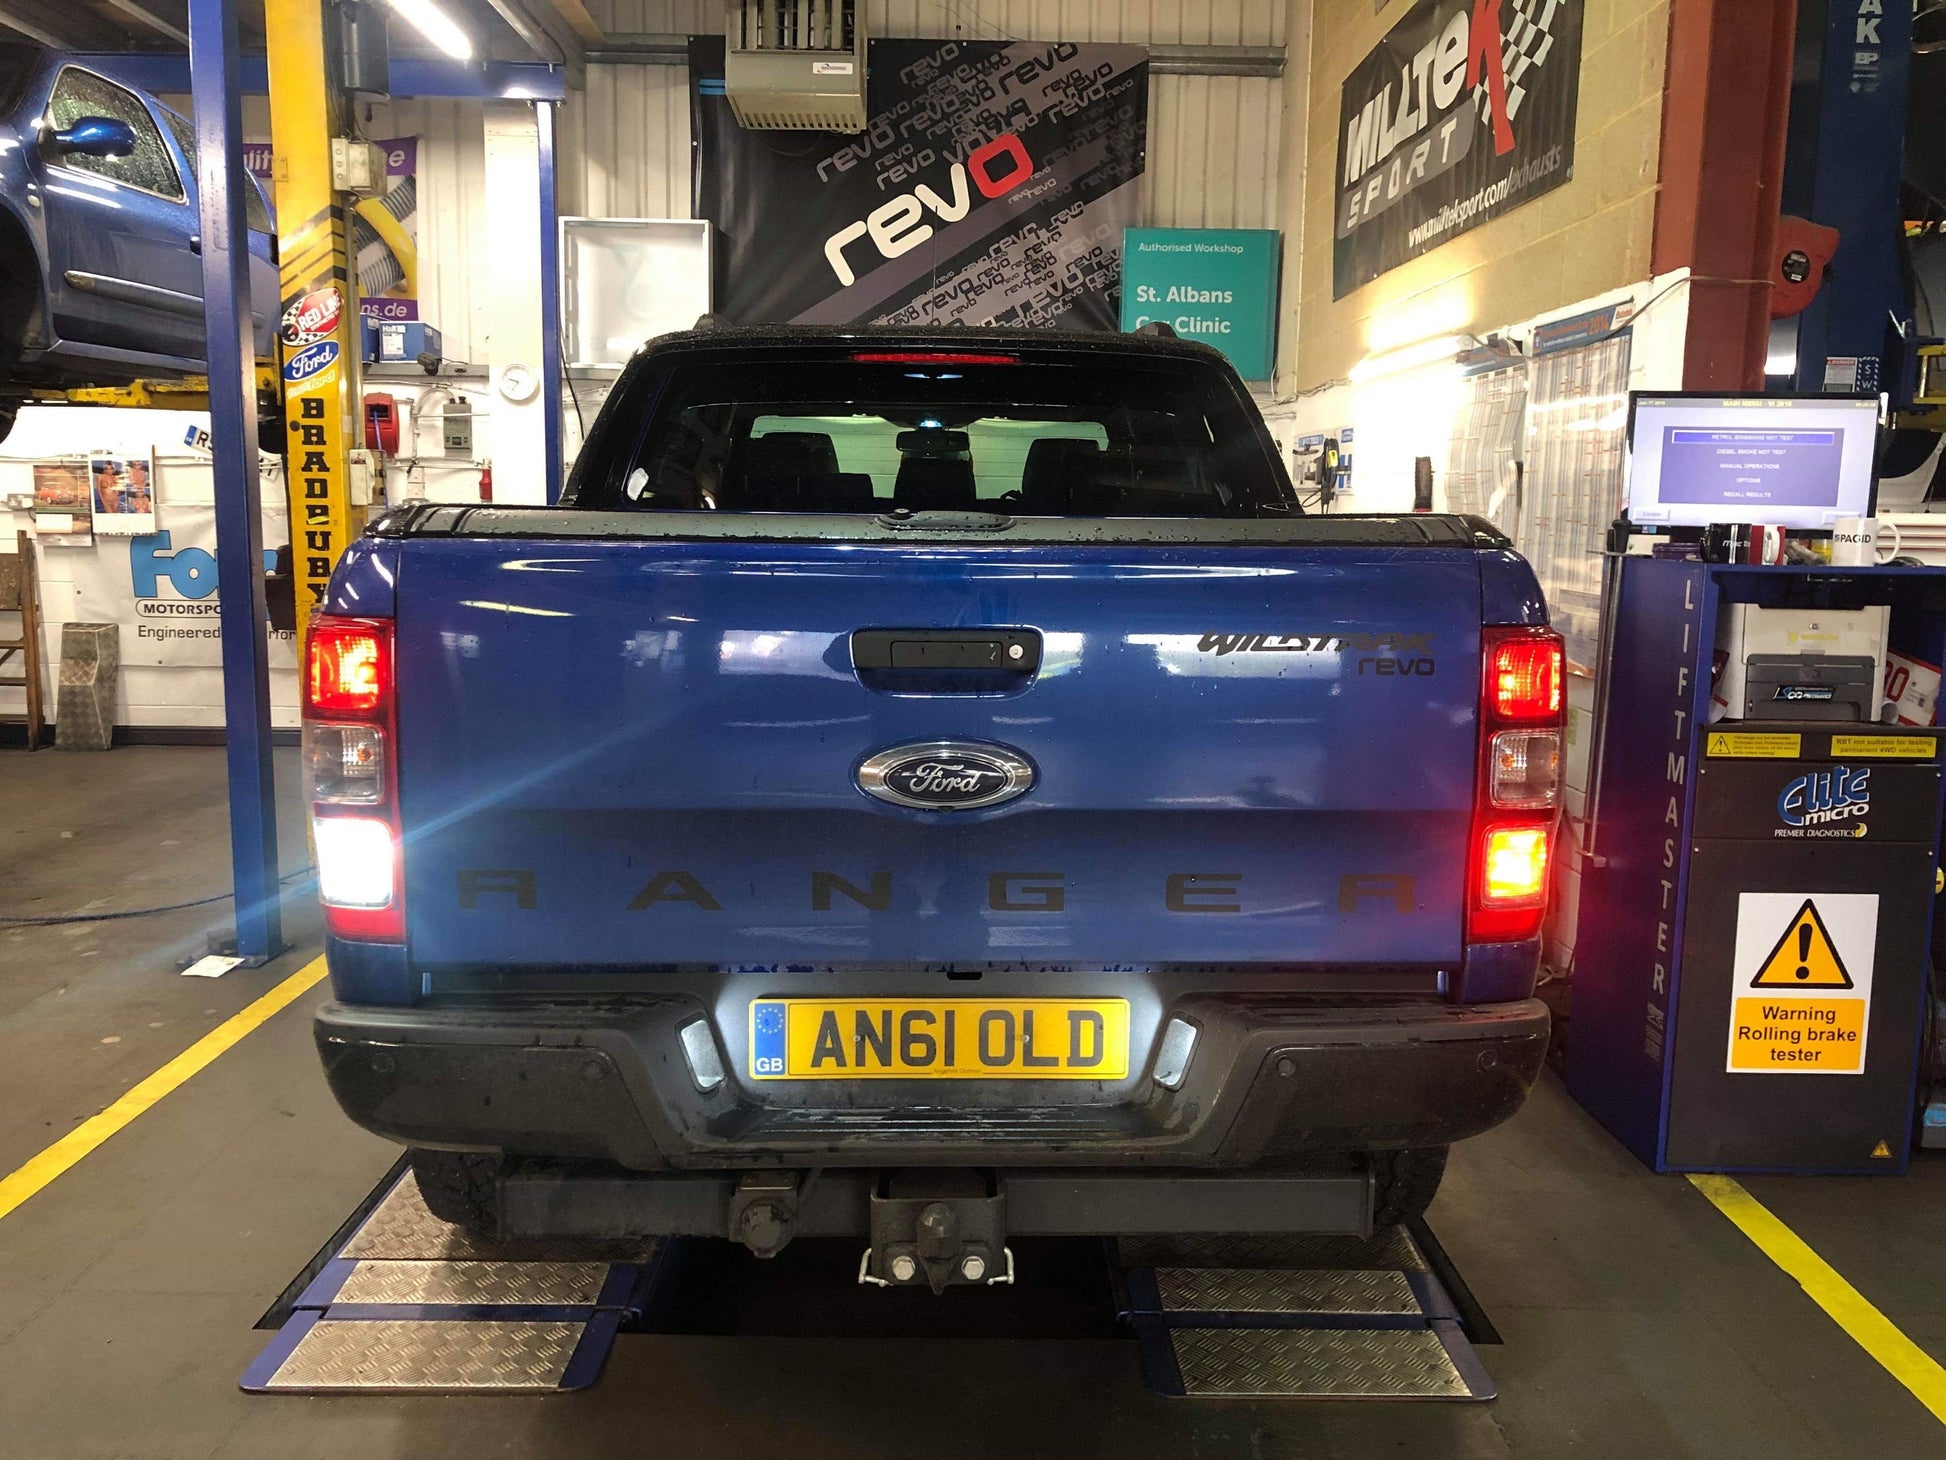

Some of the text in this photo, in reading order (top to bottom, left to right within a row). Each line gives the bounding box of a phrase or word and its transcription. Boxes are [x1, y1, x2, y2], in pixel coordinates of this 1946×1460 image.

[900, 42, 959, 84] revo
[999, 42, 1079, 95] revo
[900, 94, 961, 139] revo
[1048, 84, 1106, 125] revo
[816, 122, 896, 183] revo
[875, 143, 914, 171] revo
[877, 148, 936, 190] revo
[1347, 116, 1457, 229] SPORT
[824, 133, 1034, 287] revo
[1066, 246, 1103, 274] revo
[1138, 242, 1244, 255] Authorised Workshop
[977, 258, 1011, 282] revo
[921, 278, 975, 316] revo
[965, 272, 1005, 301] revo
[1136, 285, 1233, 304] St. Albans
[297, 307, 322, 331] RED
[950, 298, 978, 317] revo
[1174, 316, 1231, 334] Clinic
[291, 345, 334, 379] Ford
[1840, 534, 1872, 543] PAGID
[143, 603, 221, 615] MOTORSPO
[138, 625, 220, 641] Engineered
[1358, 657, 1436, 677] revo
[1908, 739, 1933, 748] testing
[909, 762, 981, 793] Ford
[1653, 579, 1694, 995] LIFTMASTER
[1777, 765, 1871, 827] Elite
[1805, 803, 1870, 826] micro
[1774, 828, 1855, 838] PREMIER DIAGNOSTICS
[457, 868, 1416, 915] RANGER
[1762, 1005, 1837, 1024] Warning
[810, 1008, 1105, 1069] AN61 OLD
[1738, 1026, 1857, 1045] Rolling brake
[756, 1057, 784, 1073] GB
[1770, 1047, 1822, 1062] tester
